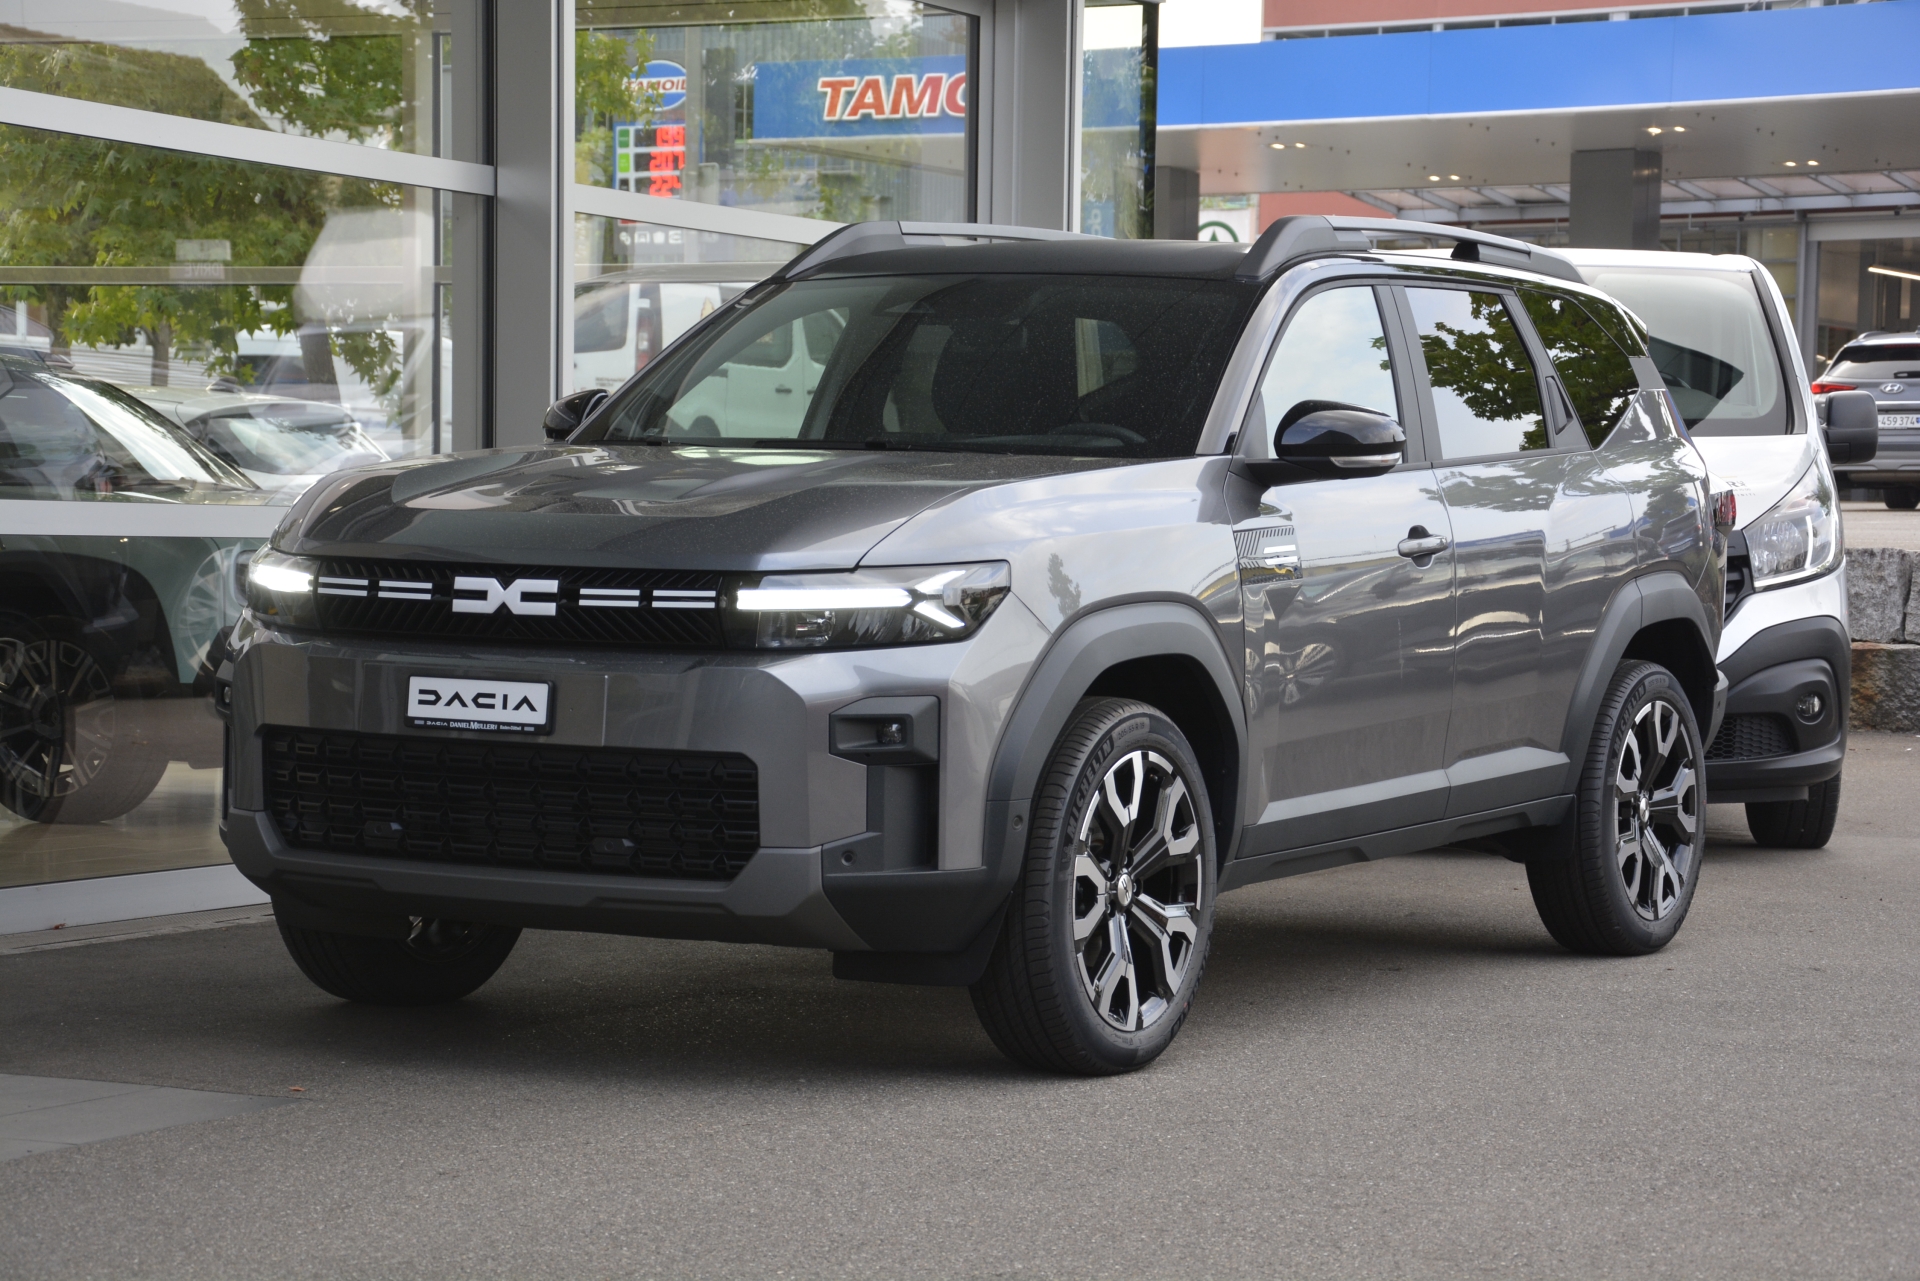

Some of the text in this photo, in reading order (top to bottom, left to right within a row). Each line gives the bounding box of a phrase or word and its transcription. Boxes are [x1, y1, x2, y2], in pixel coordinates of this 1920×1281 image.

[418, 689, 538, 712] DACIA
[1614, 683, 1646, 754] MICHELIN
[1066, 736, 1114, 839] MICHELIN
